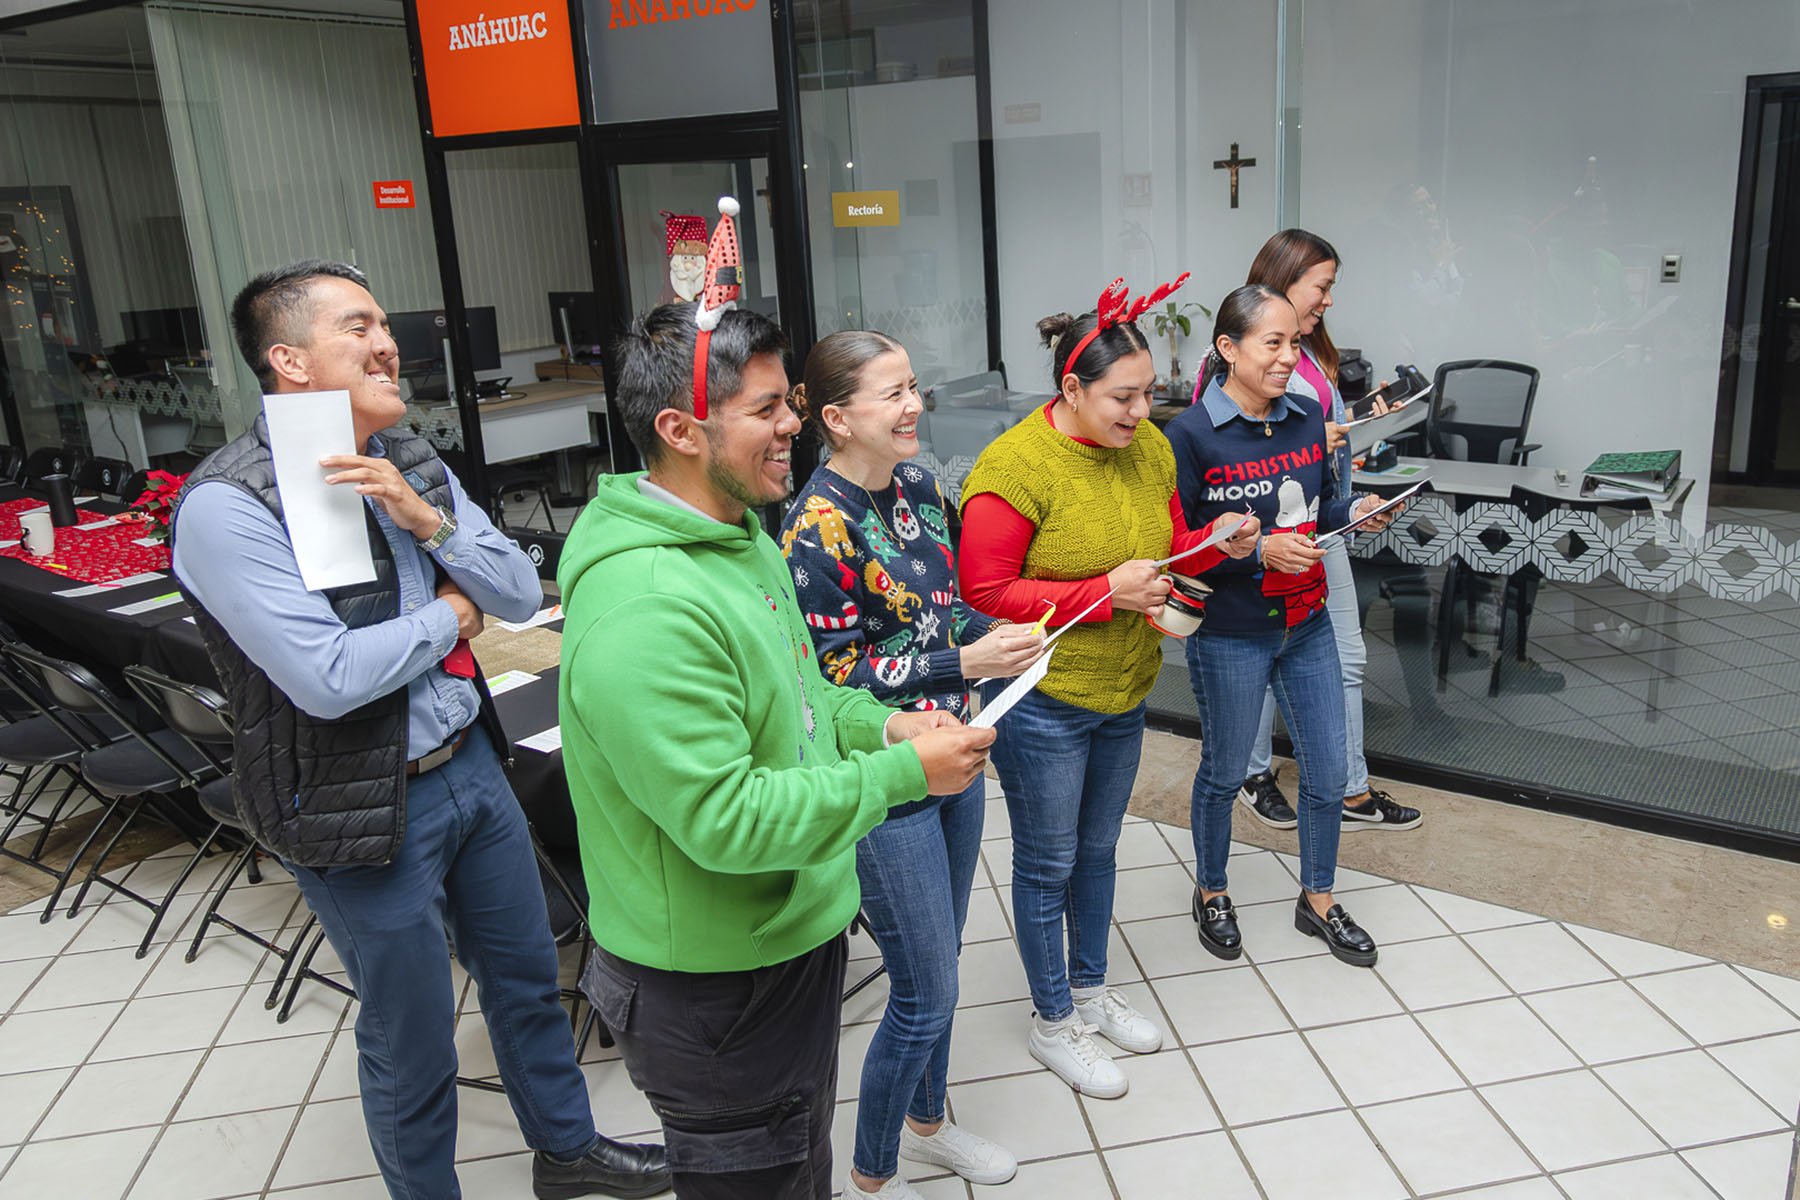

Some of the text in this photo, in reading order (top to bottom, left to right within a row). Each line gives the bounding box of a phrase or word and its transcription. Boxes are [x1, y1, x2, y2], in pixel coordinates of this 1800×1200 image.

[448, 11, 548, 51] ANÁHUAC
[848, 203, 884, 216] Rectoría
[1204, 442, 1325, 485] CHRISTMA
[1207, 480, 1274, 502] MOOD
